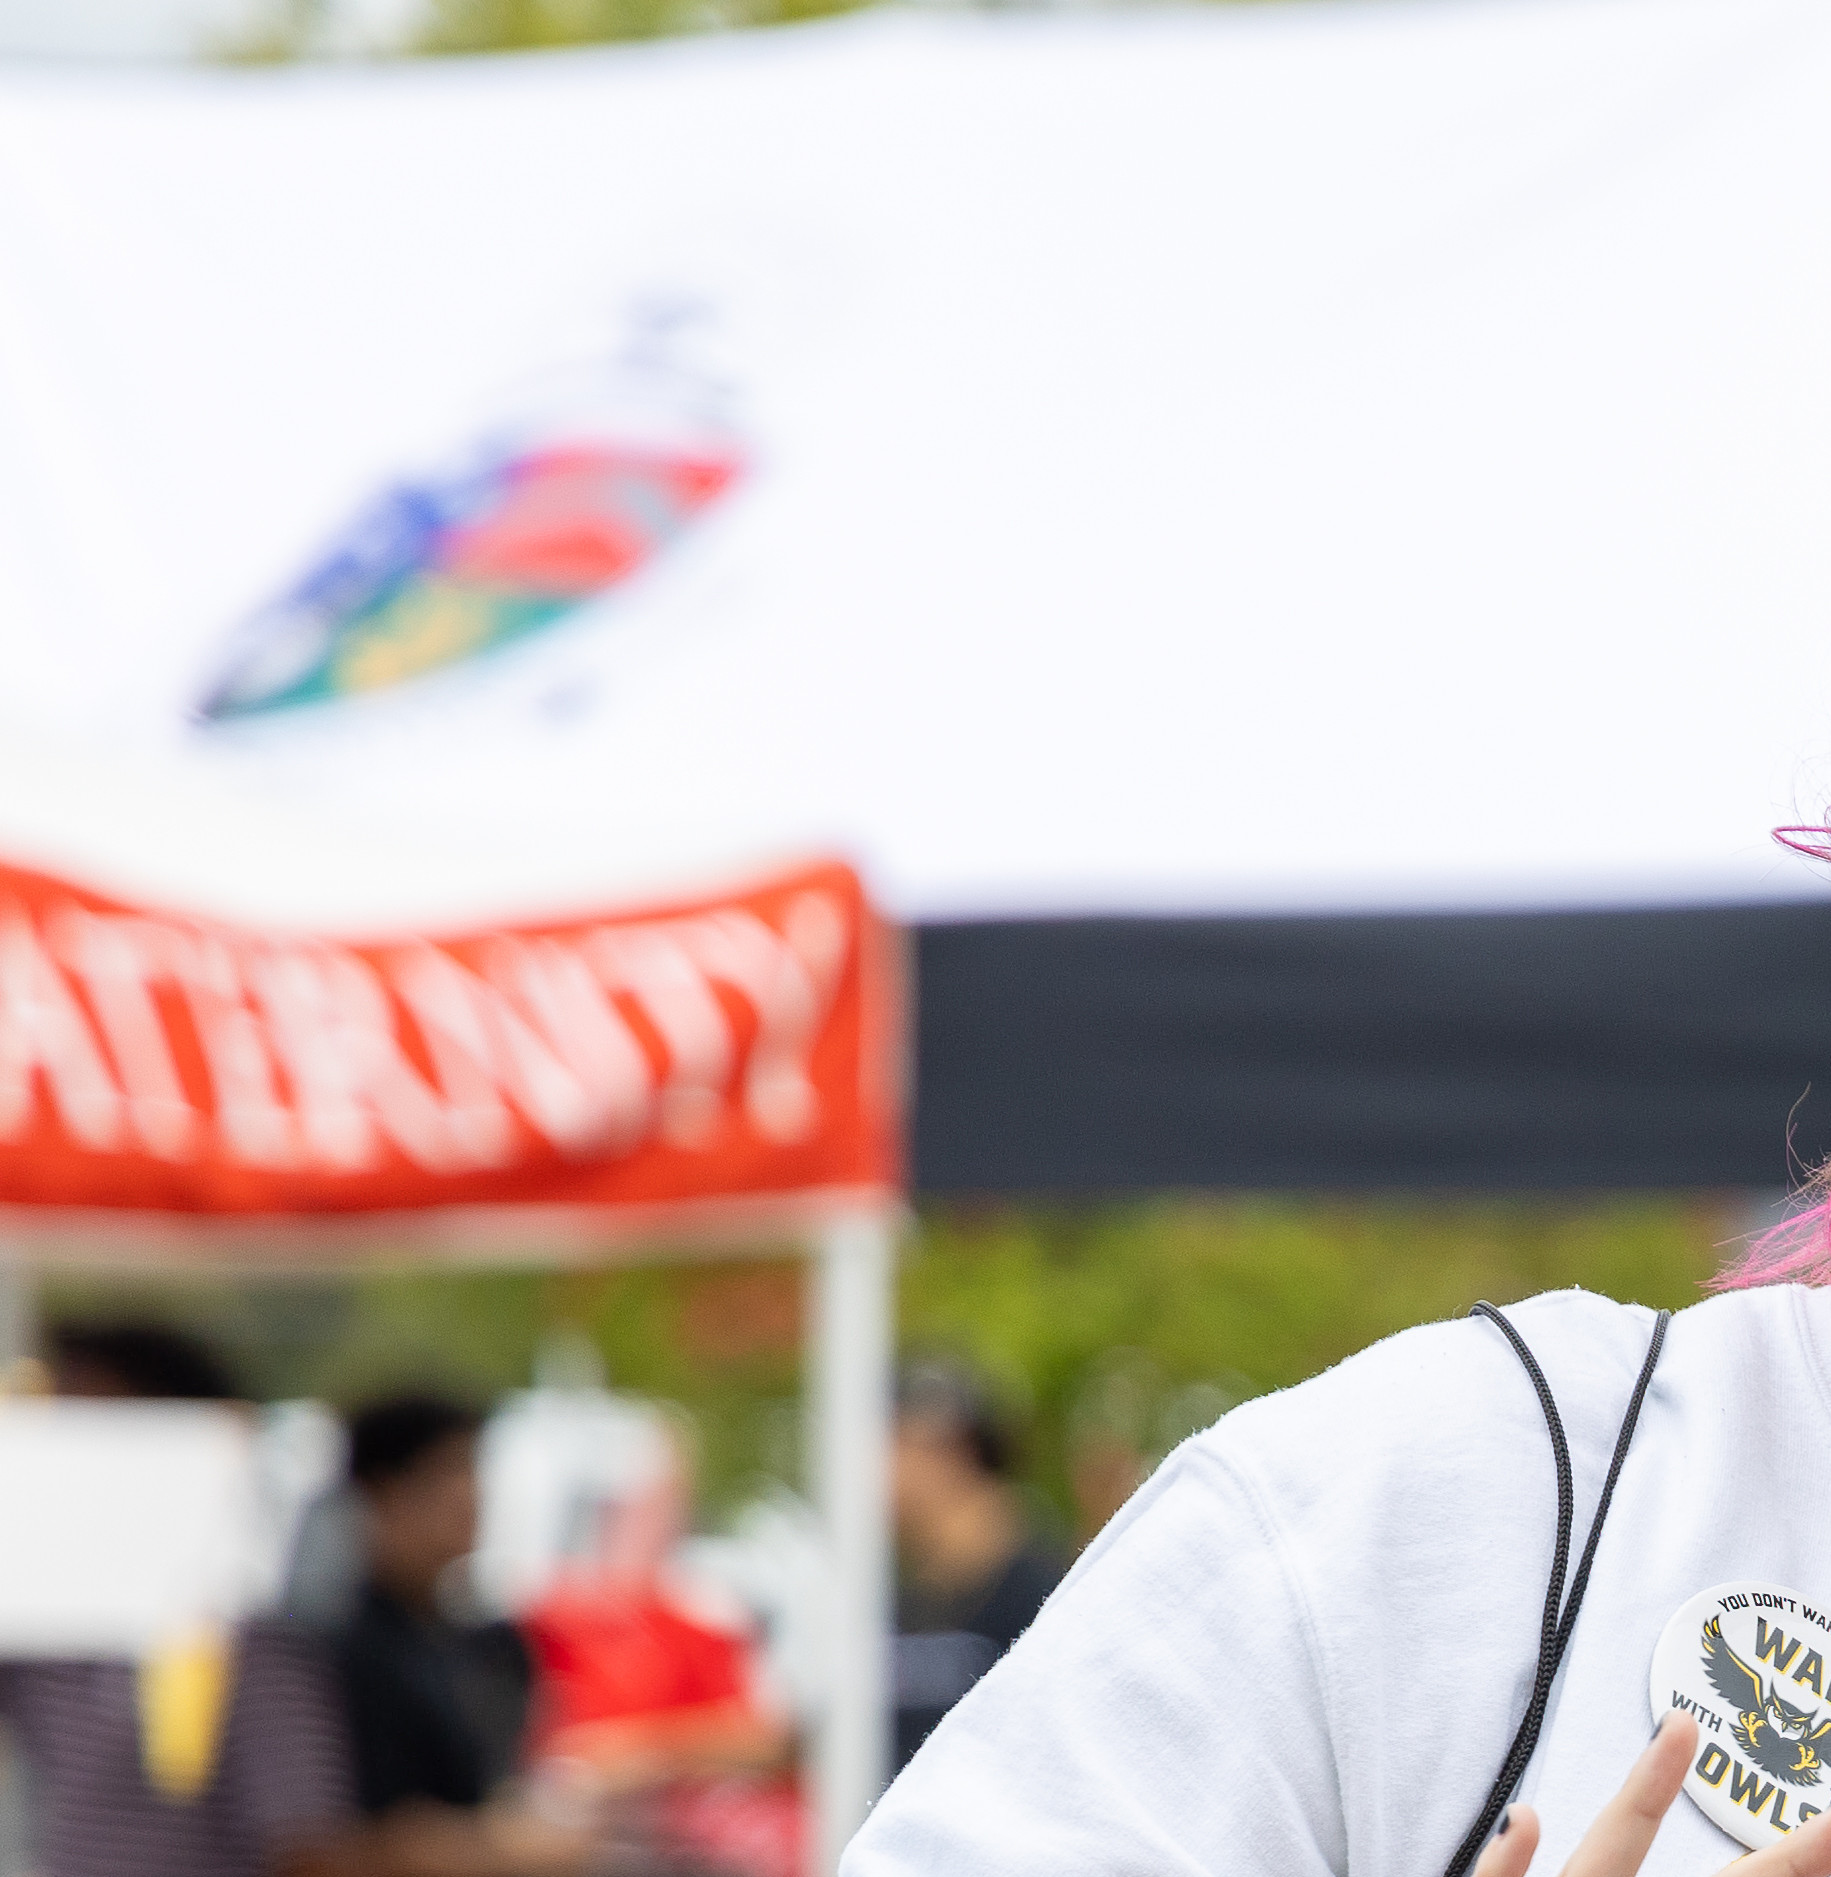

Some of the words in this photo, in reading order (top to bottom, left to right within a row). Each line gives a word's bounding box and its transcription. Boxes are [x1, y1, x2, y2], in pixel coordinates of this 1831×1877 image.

[1717, 1593, 1749, 1612] YOU
[1751, 1592, 1797, 1613] DON'T
[1672, 1690, 1723, 1733] WITH
